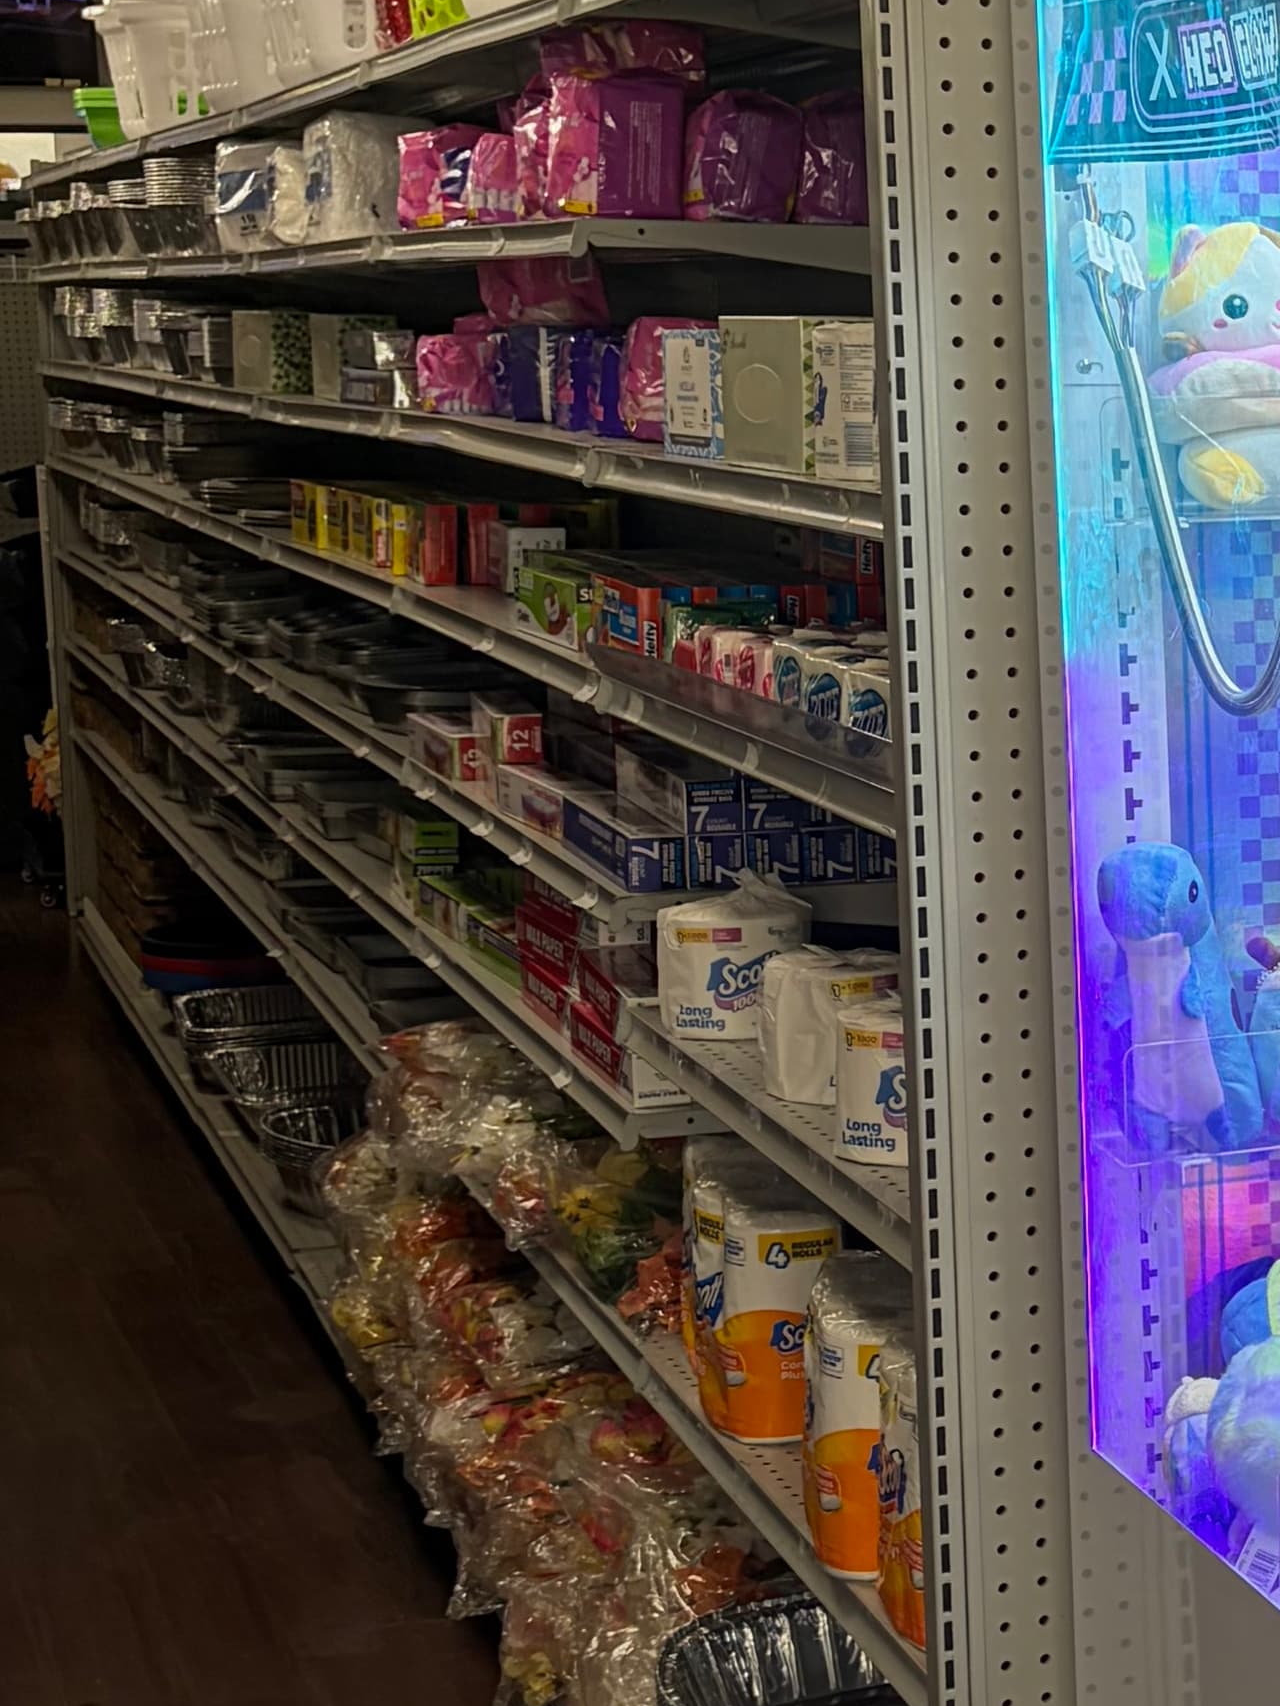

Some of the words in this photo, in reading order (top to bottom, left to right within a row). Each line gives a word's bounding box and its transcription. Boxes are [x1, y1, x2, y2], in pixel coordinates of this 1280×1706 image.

[1182, 27, 1234, 91] NEO
[1233, 10, 1279, 83] CLAW
[690, 805, 710, 832] 7
[748, 803, 768, 830] 7
[631, 842, 660, 860] 7
[826, 859, 854, 878] 7
[719, 950, 777, 995] Sco
[680, 1005, 712, 1021] Long
[732, 994, 761, 1013] 100
[676, 1017, 725, 1032] Lasting
[847, 1118, 882, 1138] Long
[842, 1131, 896, 1152] Lasting
[699, 1215, 724, 1232] REGULA
[765, 1242, 791, 1269] 4
[792, 1247, 823, 1259] ROLLS
